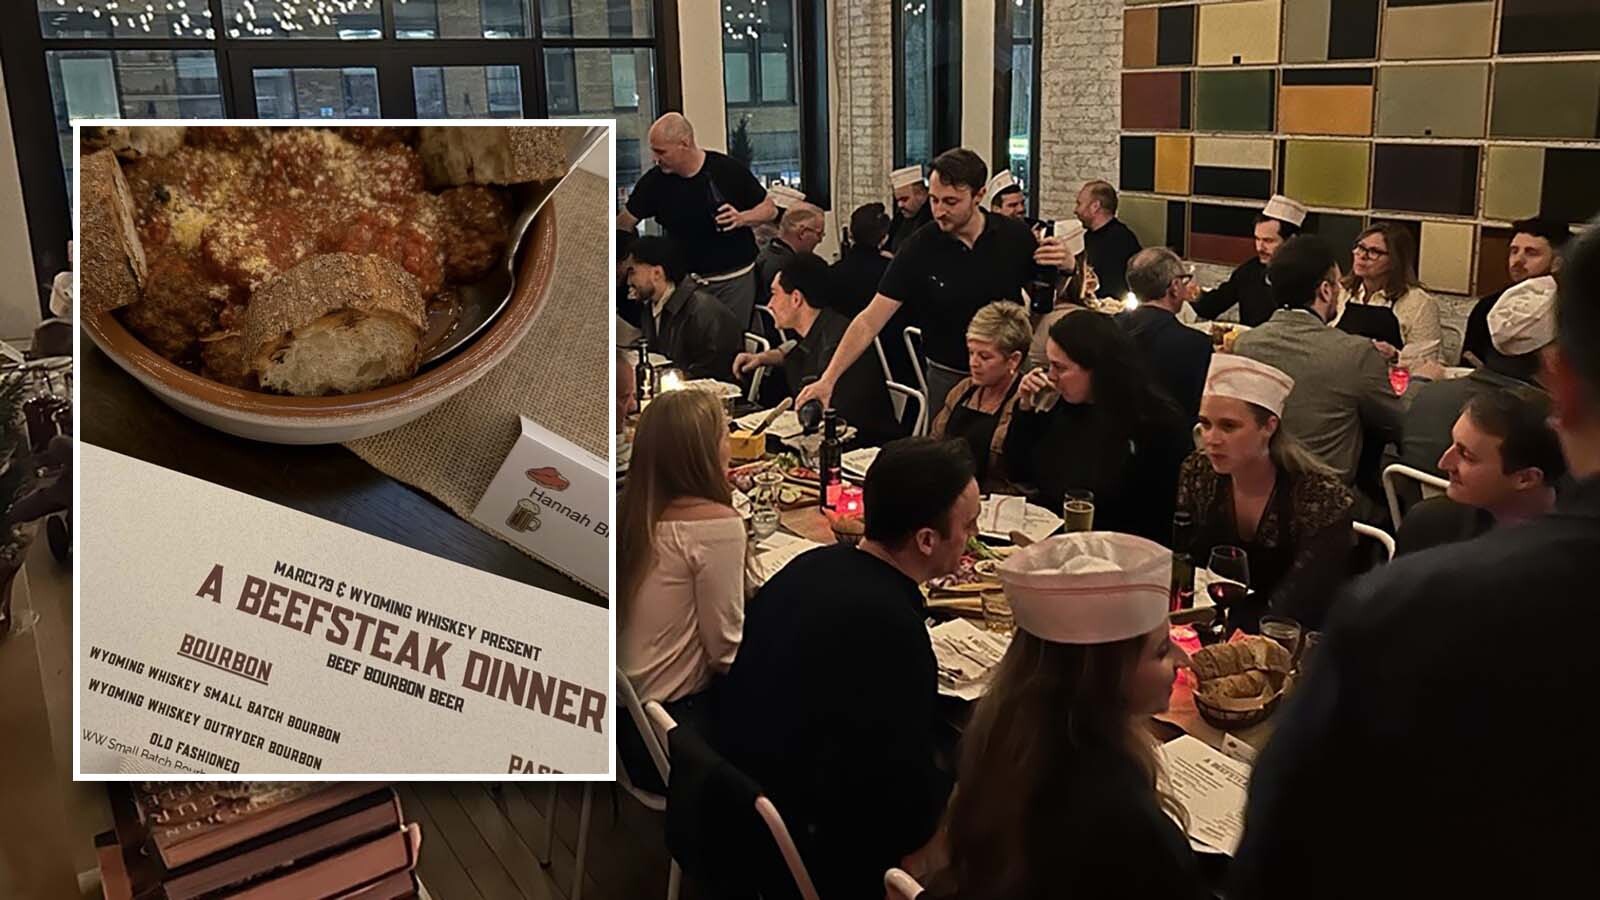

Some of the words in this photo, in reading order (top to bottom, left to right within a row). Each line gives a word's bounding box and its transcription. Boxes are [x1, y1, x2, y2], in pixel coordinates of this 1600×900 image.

[529, 487, 591, 527] Hannah
[274, 560, 334, 593] MARC179
[350, 586, 413, 619] WYOMING
[415, 608, 477, 640] WHISKEY
[480, 629, 542, 661] PRESENT
[179, 633, 273, 682] BOURBON
[196, 564, 224, 604] A
[236, 574, 452, 681] BEEFSTEAK
[461, 649, 607, 734] DINNER
[89, 646, 146, 675] WYOMING
[148, 665, 201, 694] WHISKEY
[203, 685, 243, 710] SMALL
[246, 700, 285, 724] BATCH
[287, 714, 341, 744] BOURBON
[326, 653, 362, 676] BEEF
[363, 665, 426, 700] BOURBON
[428, 687, 465, 713] BEER
[88, 678, 145, 708] WYOMING
[147, 698, 201, 727] WHISKEY
[203, 717, 266, 750] OUTRYDER
[268, 740, 323, 771] BOURBON
[107, 737, 140, 757] Small
[149, 732, 174, 751] OLD
[175, 741, 241, 774] FASHIONED
[507, 753, 565, 774] PA
